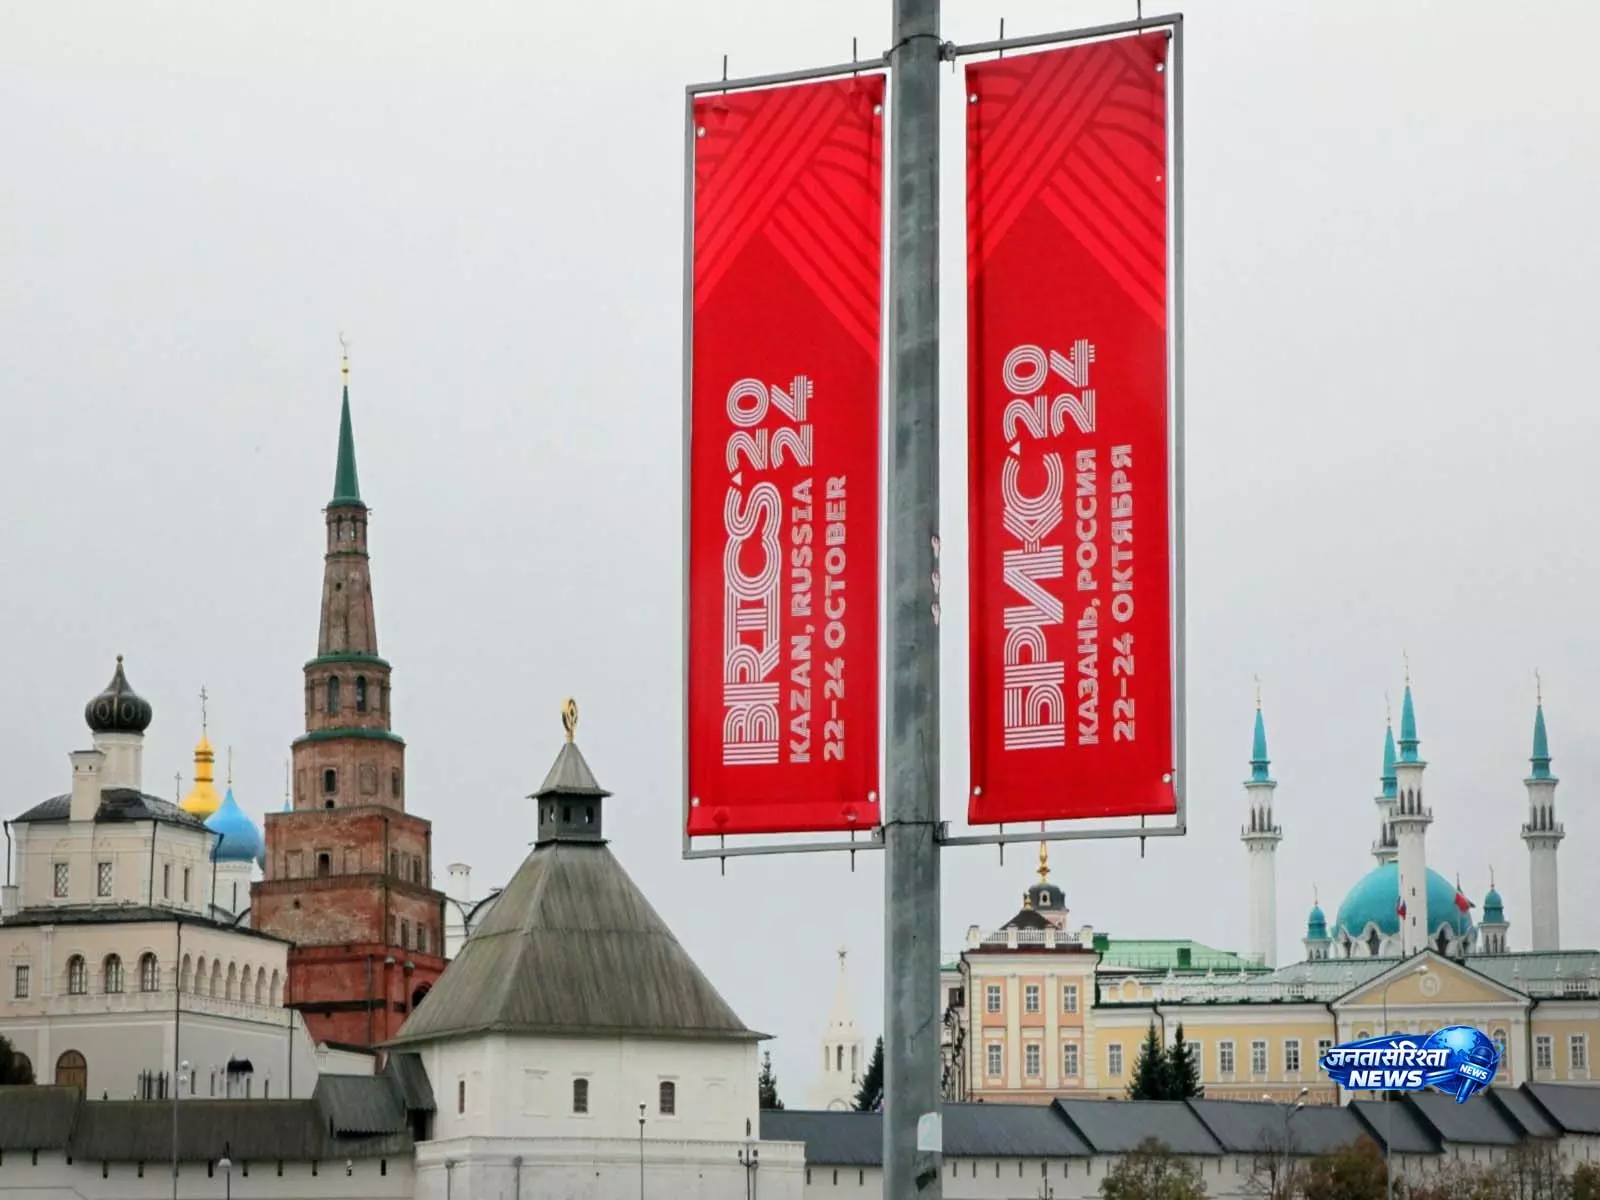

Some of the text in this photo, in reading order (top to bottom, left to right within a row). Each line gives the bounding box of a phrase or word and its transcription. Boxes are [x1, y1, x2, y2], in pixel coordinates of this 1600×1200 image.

[722, 481, 783, 766] BRICS
[790, 478, 814, 763] KAZAN, RUSSIA
[825, 475, 846, 649] OCTOBER
[1001, 452, 1065, 751] БРИКС
[1077, 449, 1100, 745] КАЗАНЬ, РОССИЯ
[1111, 444, 1133, 623] ОКТЯБРЯ
